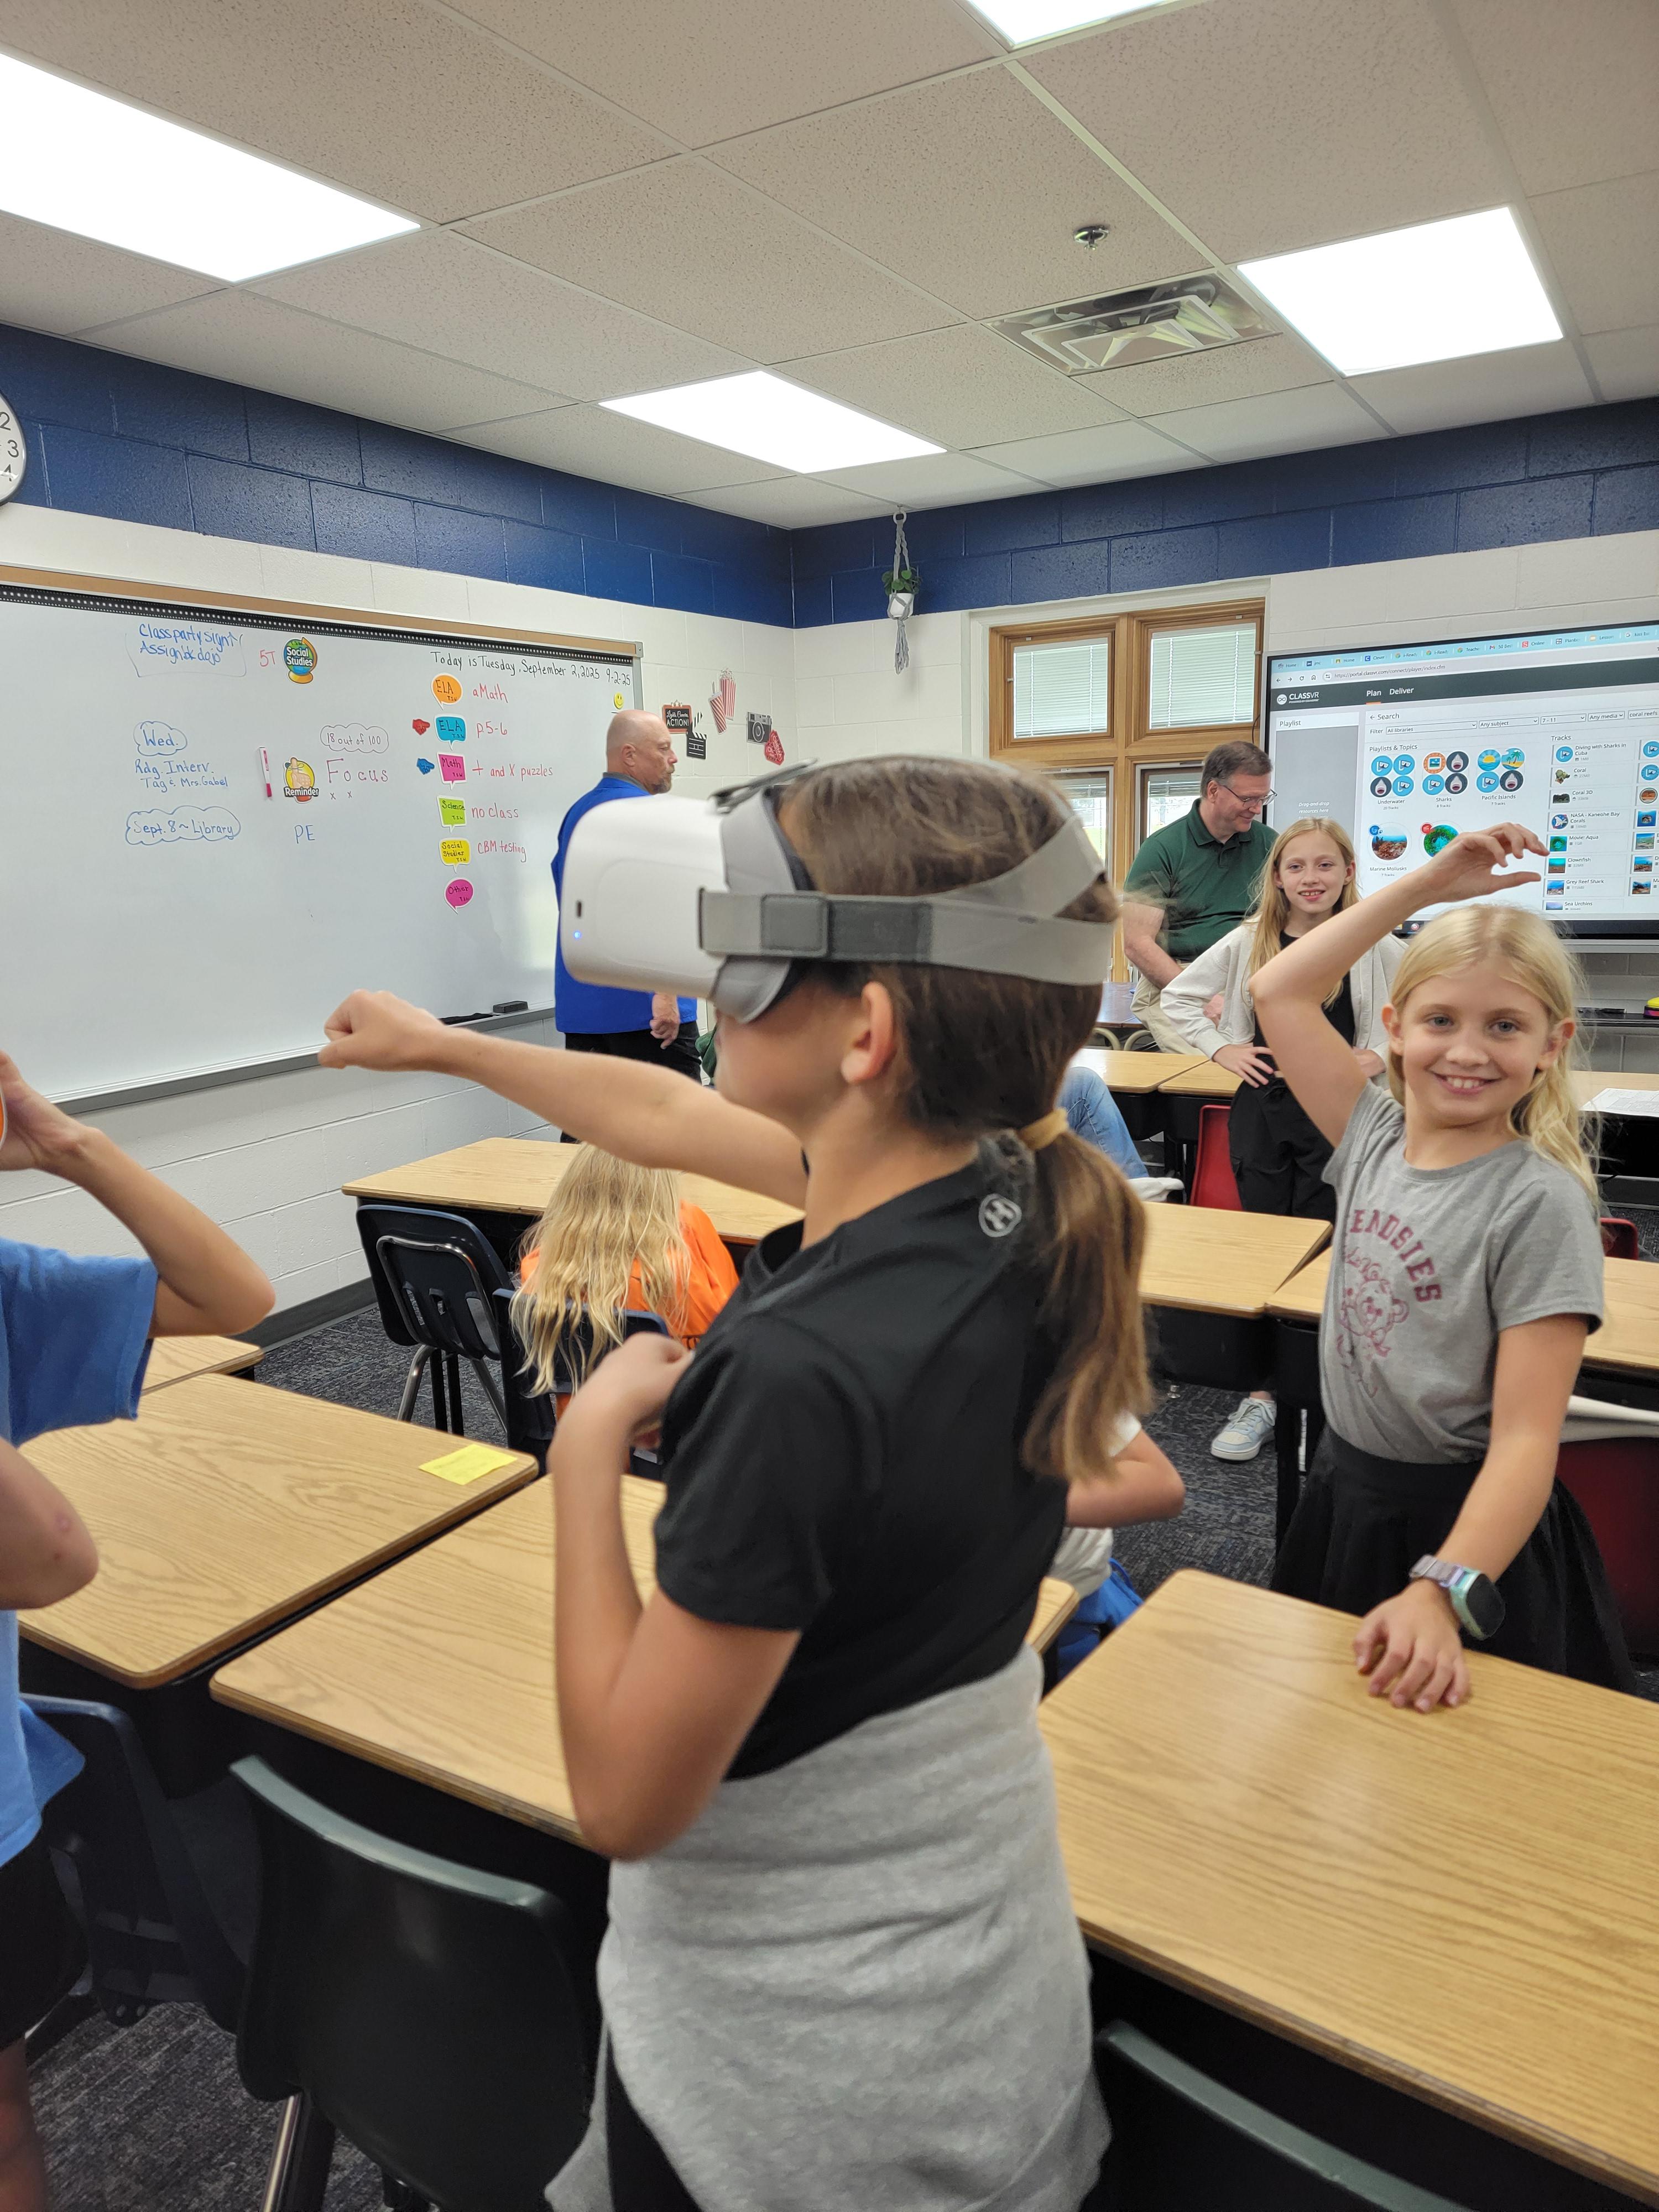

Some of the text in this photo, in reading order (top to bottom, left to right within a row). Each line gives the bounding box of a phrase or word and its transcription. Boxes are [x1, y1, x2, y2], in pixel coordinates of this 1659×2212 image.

[8, 440, 19, 458] 3
[286, 646, 309, 658] Social
[286, 655, 314, 667] Studies
[430, 651, 462, 671] Today
[469, 655, 477, 667] is
[523, 659, 566, 678] September
[436, 679, 453, 695] ELA
[439, 719, 462, 732] ELA
[666, 718, 690, 727] ACTION!
[143, 729, 179, 747] Wed.
[327, 732, 381, 745] 18 out of 100
[441, 757, 461, 769] Math
[326, 758, 388, 784] Focus
[490, 766, 505, 777] and
[521, 764, 553, 781] puzzles
[140, 777, 168, 792] Tag
[284, 787, 319, 797] Reminder
[441, 800, 466, 810] Science
[471, 802, 519, 818] no class
[168, 820, 176, 832] 8
[191, 819, 236, 840] Library
[294, 825, 315, 844] PE
[441, 841, 463, 850] Social
[478, 840, 527, 863] CBM testing
[448, 885, 469, 895] Other
